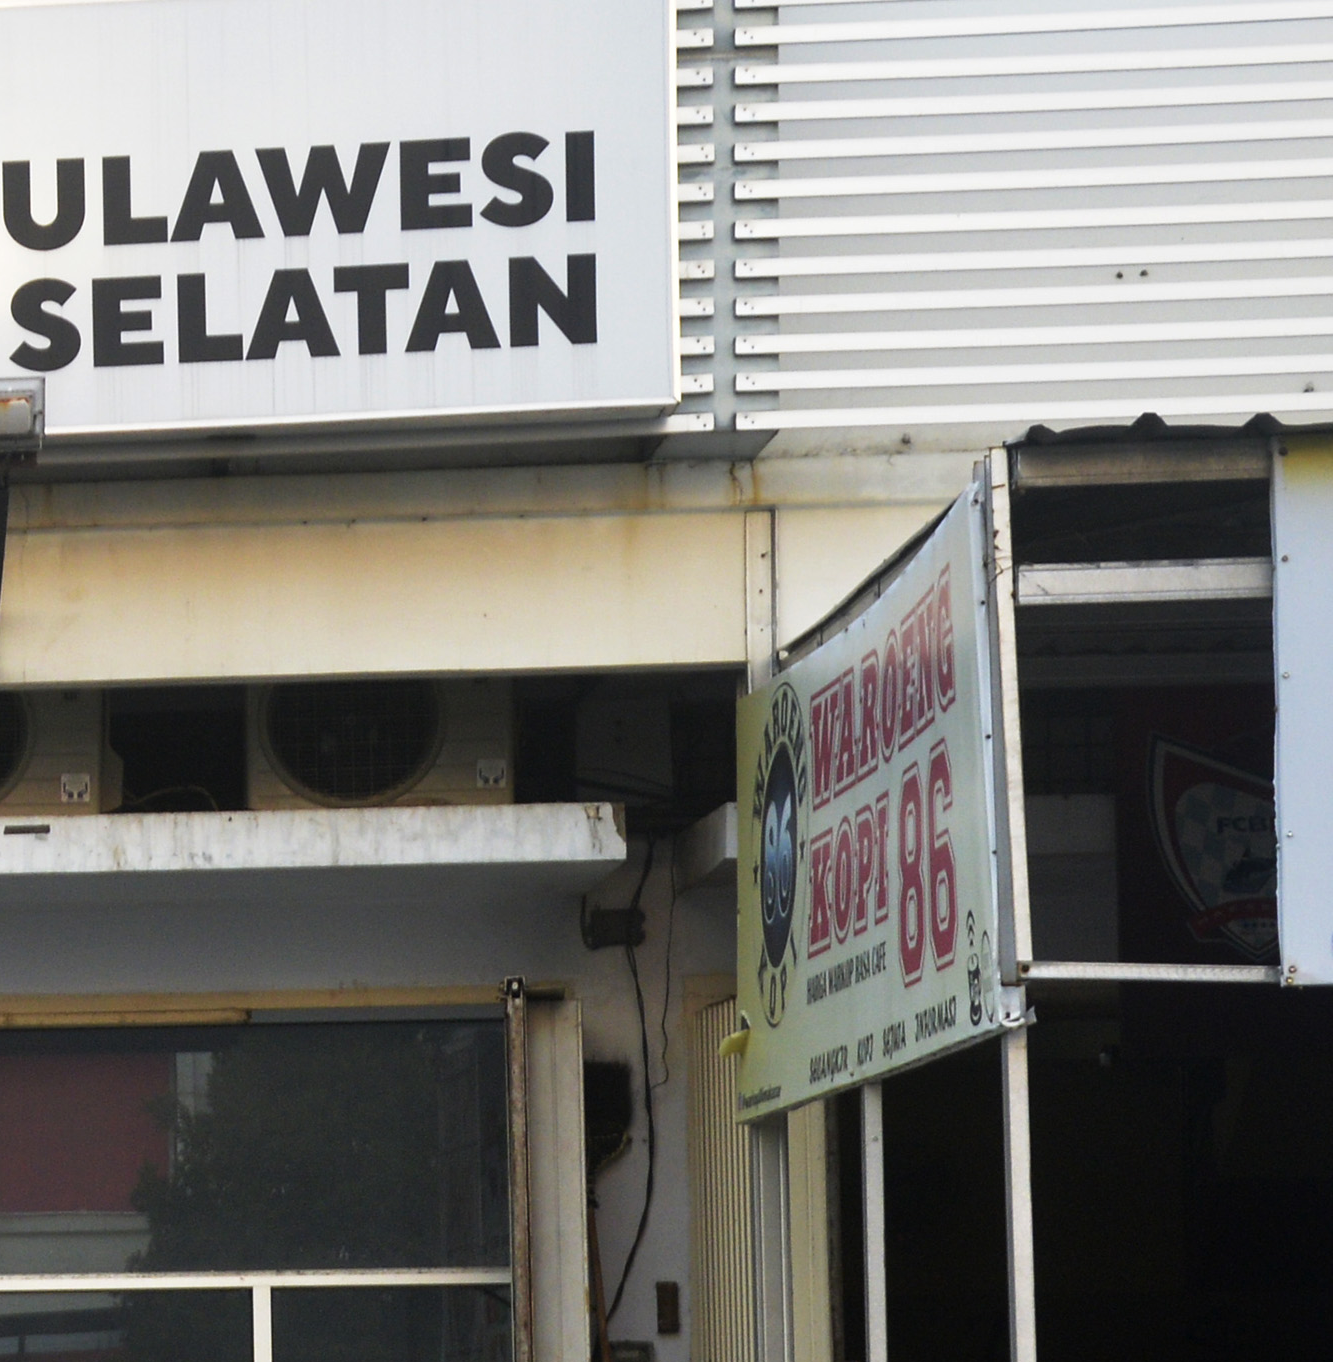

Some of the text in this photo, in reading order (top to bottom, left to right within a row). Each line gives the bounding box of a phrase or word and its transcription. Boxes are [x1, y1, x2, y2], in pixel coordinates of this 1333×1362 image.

[9, 252, 598, 373] SELATAN
[810, 564, 955, 811] WAROENG
[763, 791, 795, 925] 86
[807, 739, 959, 989] KOPI 86
